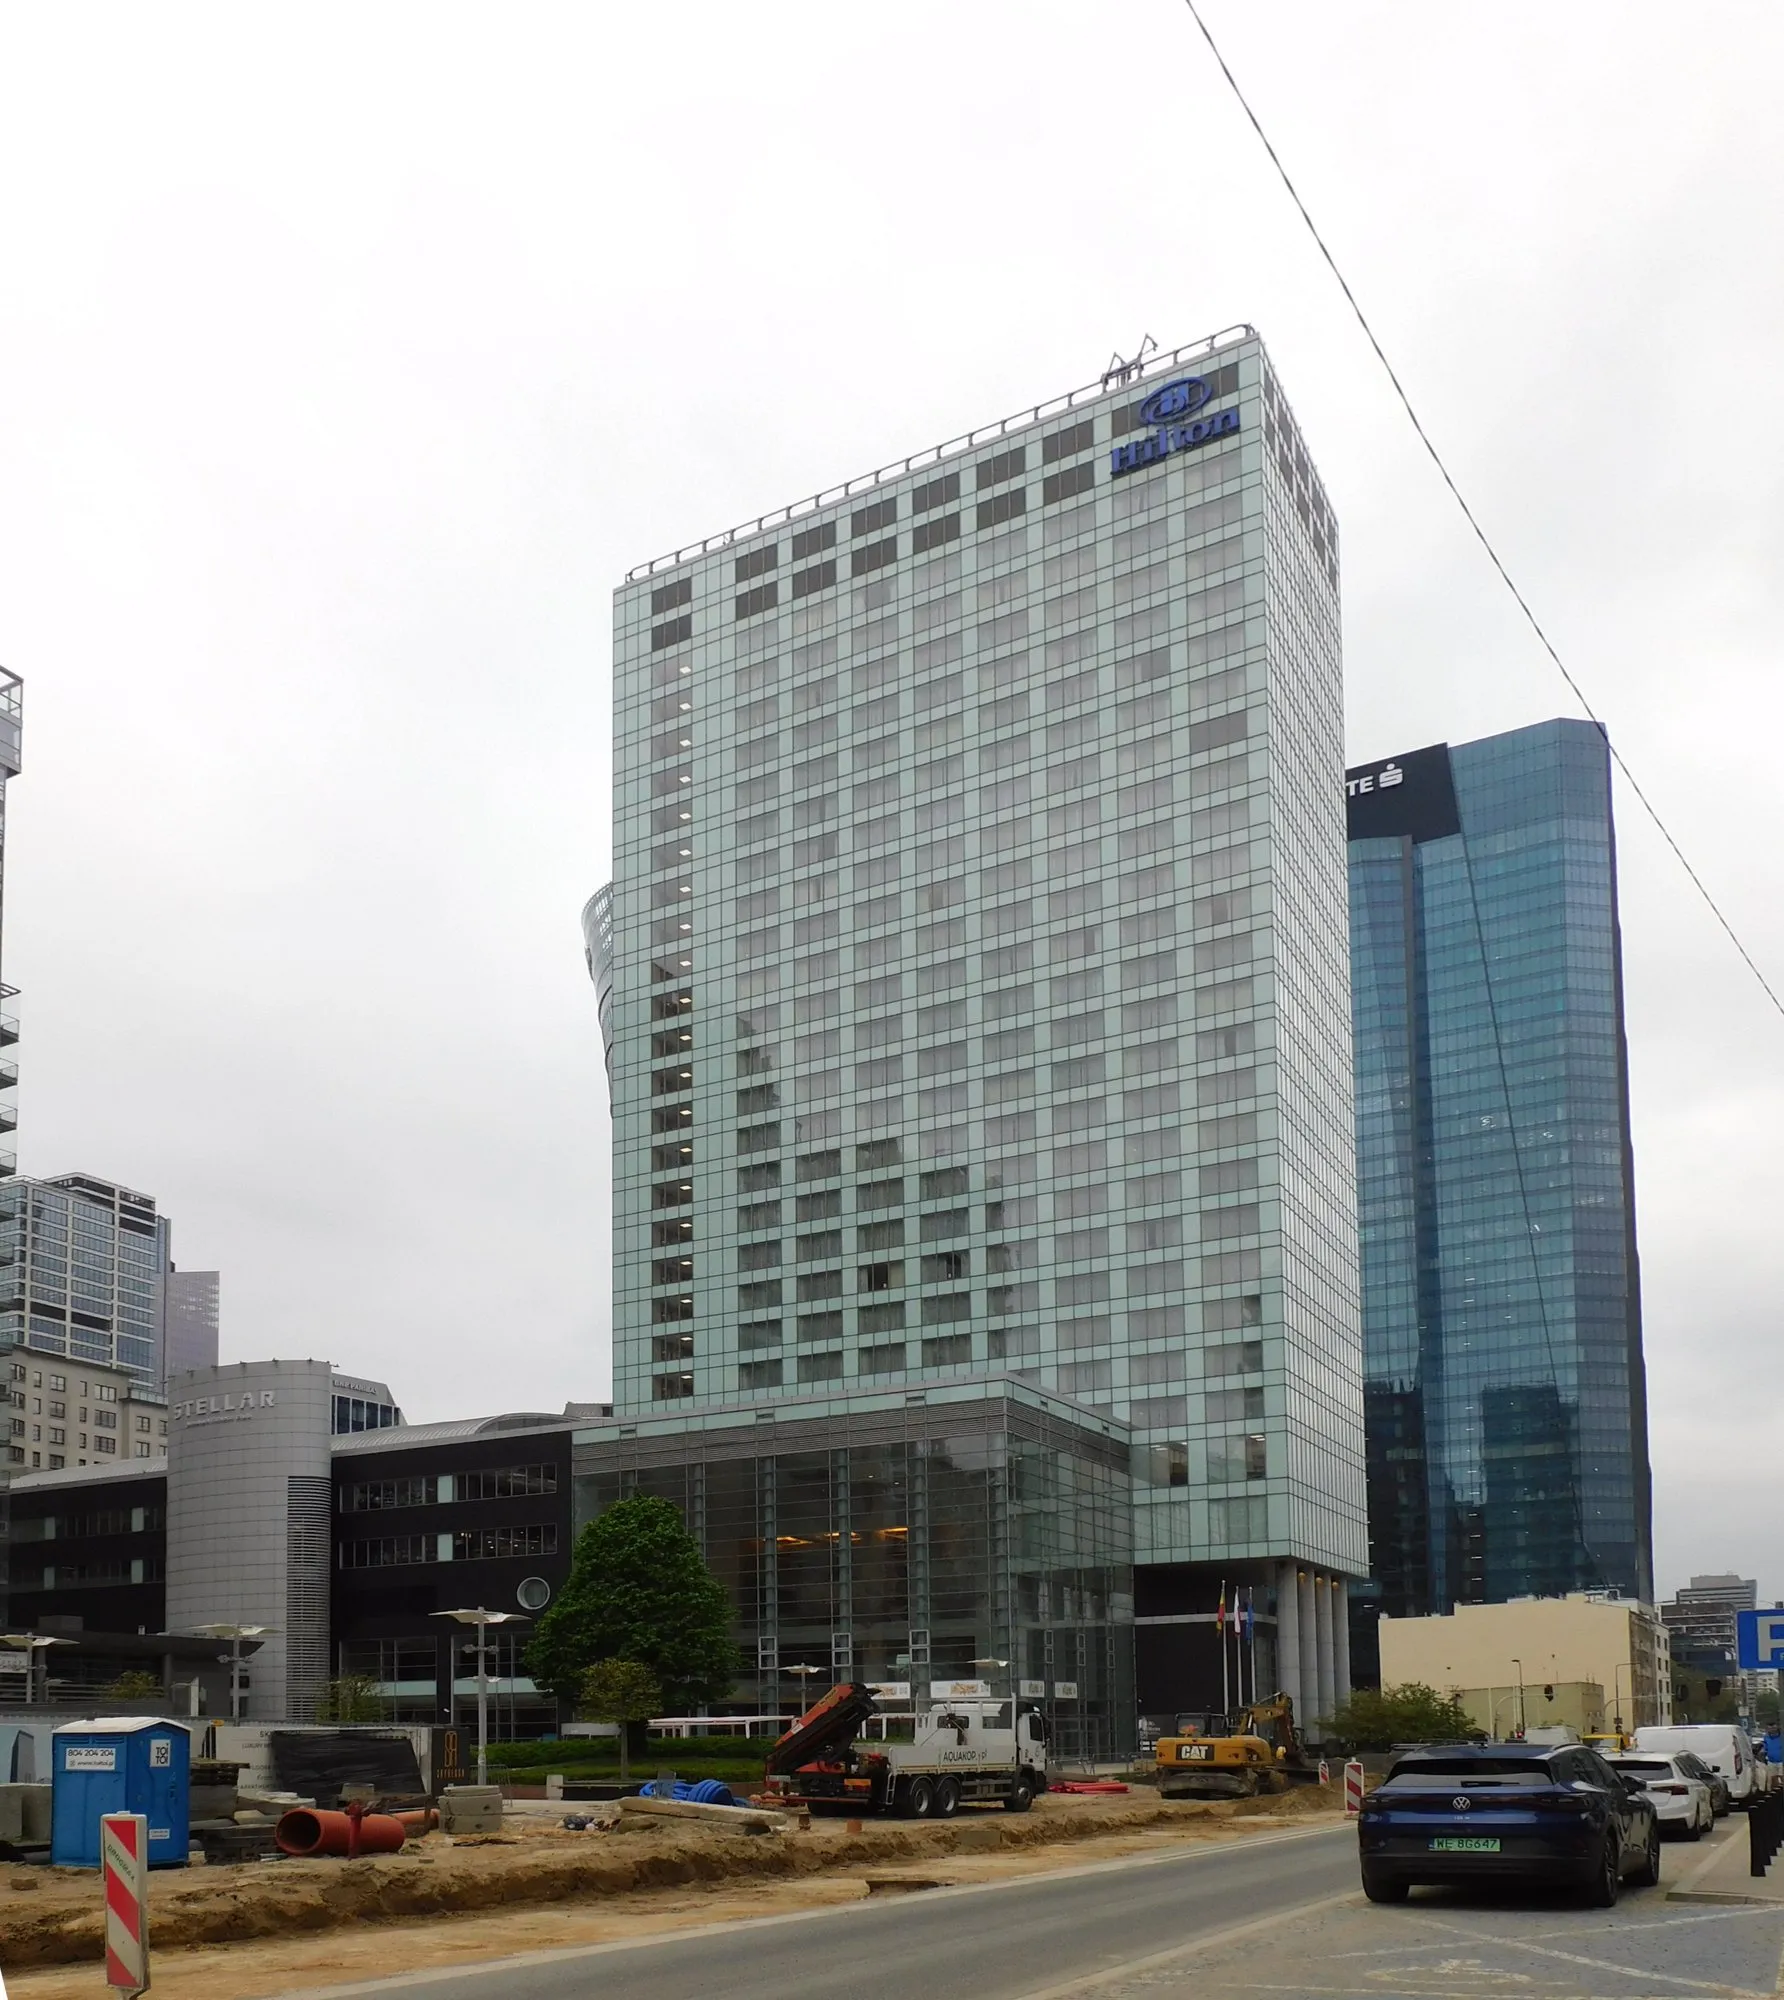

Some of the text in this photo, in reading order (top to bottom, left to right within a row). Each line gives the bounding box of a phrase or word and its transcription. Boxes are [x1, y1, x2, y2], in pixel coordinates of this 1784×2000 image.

[1110, 408, 1240, 475] Hilton
[174, 1390, 276, 1421] STELLAR
[84, 1749, 99, 1757] 204
[100, 1749, 114, 1757] 204
[1181, 1745, 1209, 1760] CAT
[1437, 1839, 1497, 1849] WE 8G647
